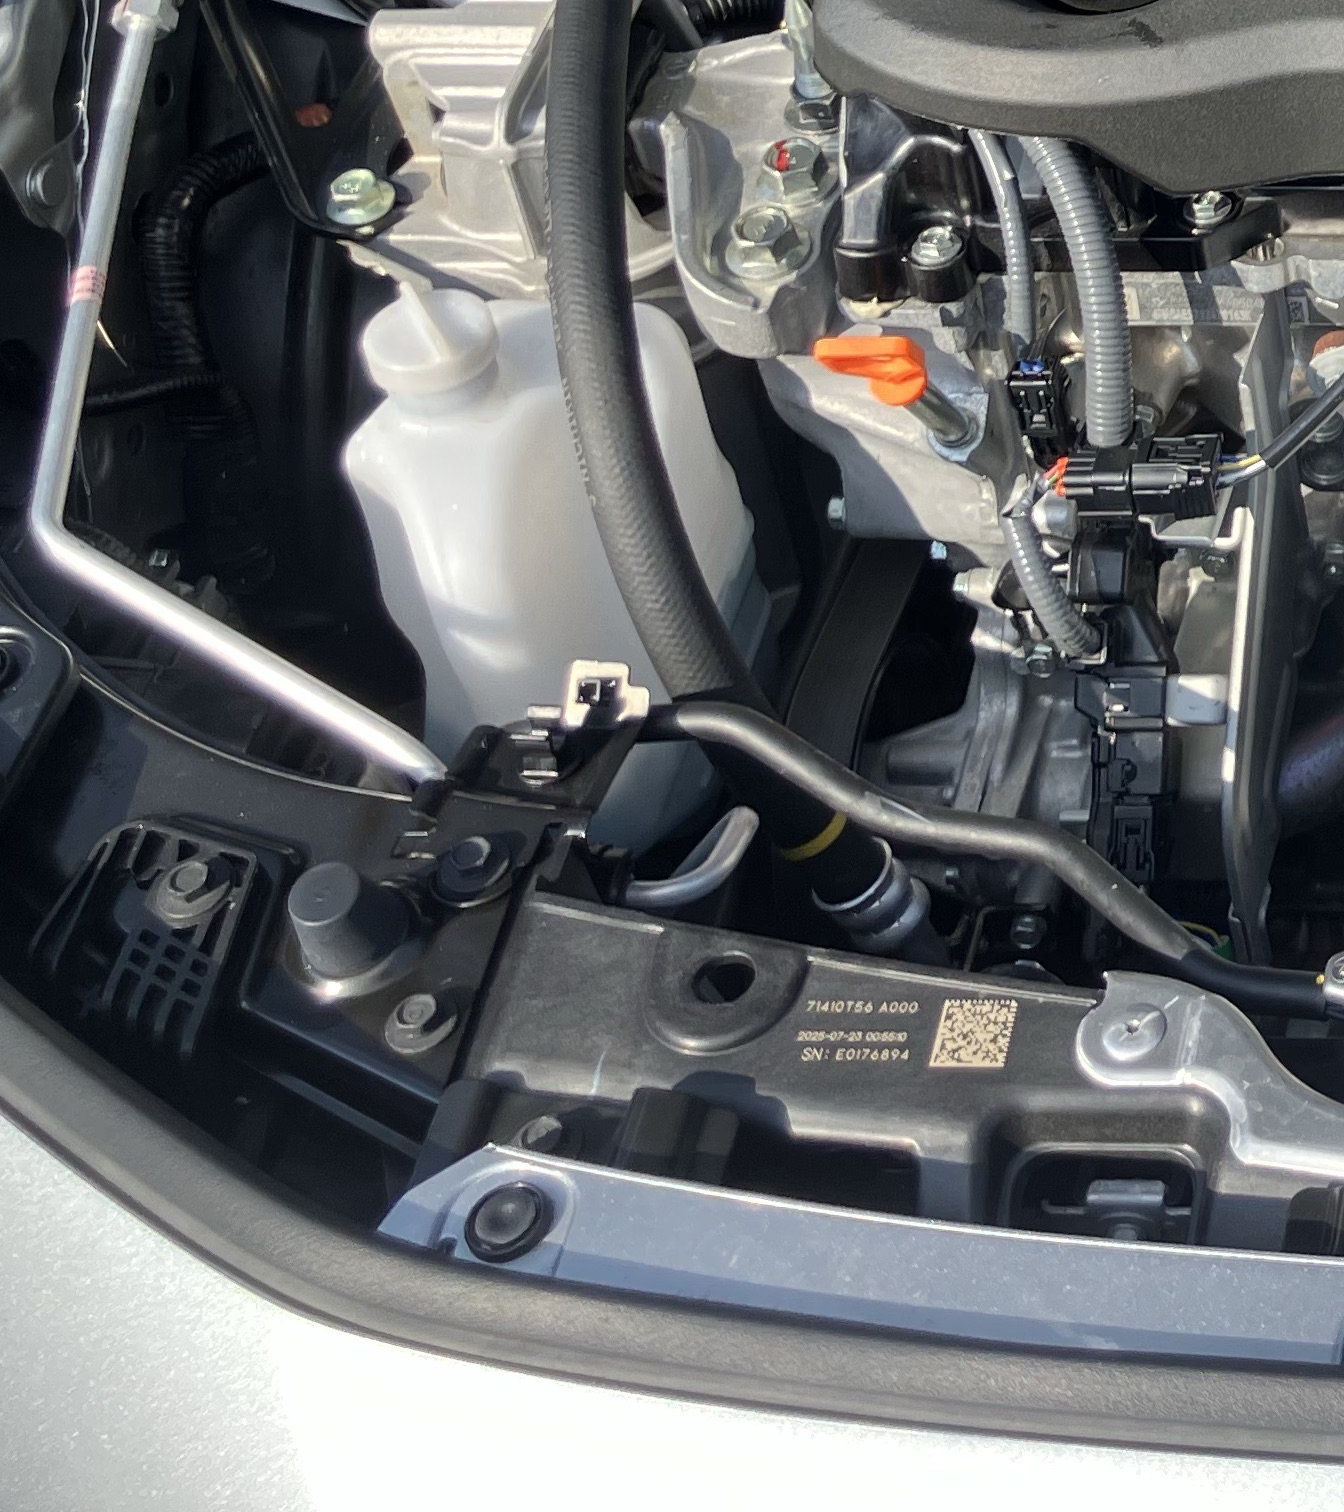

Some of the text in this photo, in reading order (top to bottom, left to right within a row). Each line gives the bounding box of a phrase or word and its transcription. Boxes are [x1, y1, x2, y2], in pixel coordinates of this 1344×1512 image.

[807, 1000, 920, 1014] 71410T56 A000
[797, 1031, 863, 1042] 2025-07-23
[801, 1046, 910, 1062] SN: E0176894
